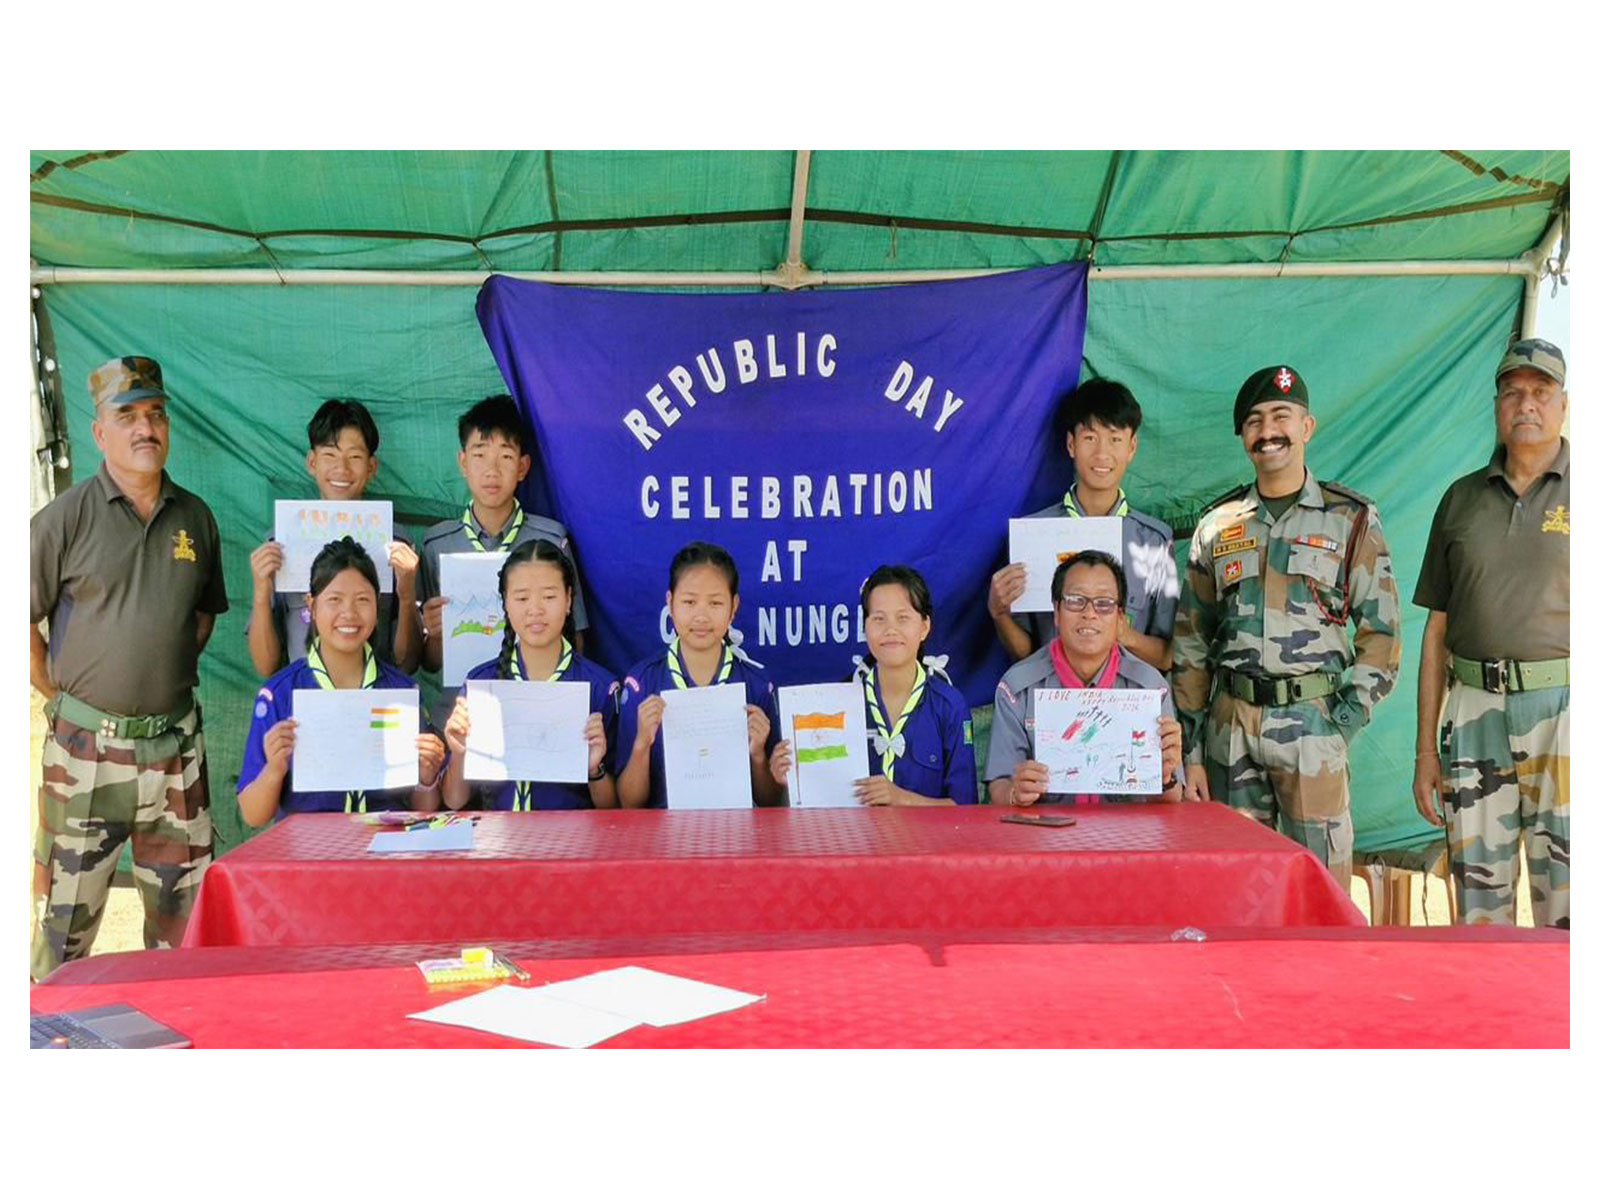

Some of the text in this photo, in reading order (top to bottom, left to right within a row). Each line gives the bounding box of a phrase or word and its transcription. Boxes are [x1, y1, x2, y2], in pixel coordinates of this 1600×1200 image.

[623, 332, 964, 450] REPUBLIC DAY
[641, 468, 932, 519] CELEBRATION
[761, 540, 807, 582] AT
[1048, 690, 1071, 701] LOVE
